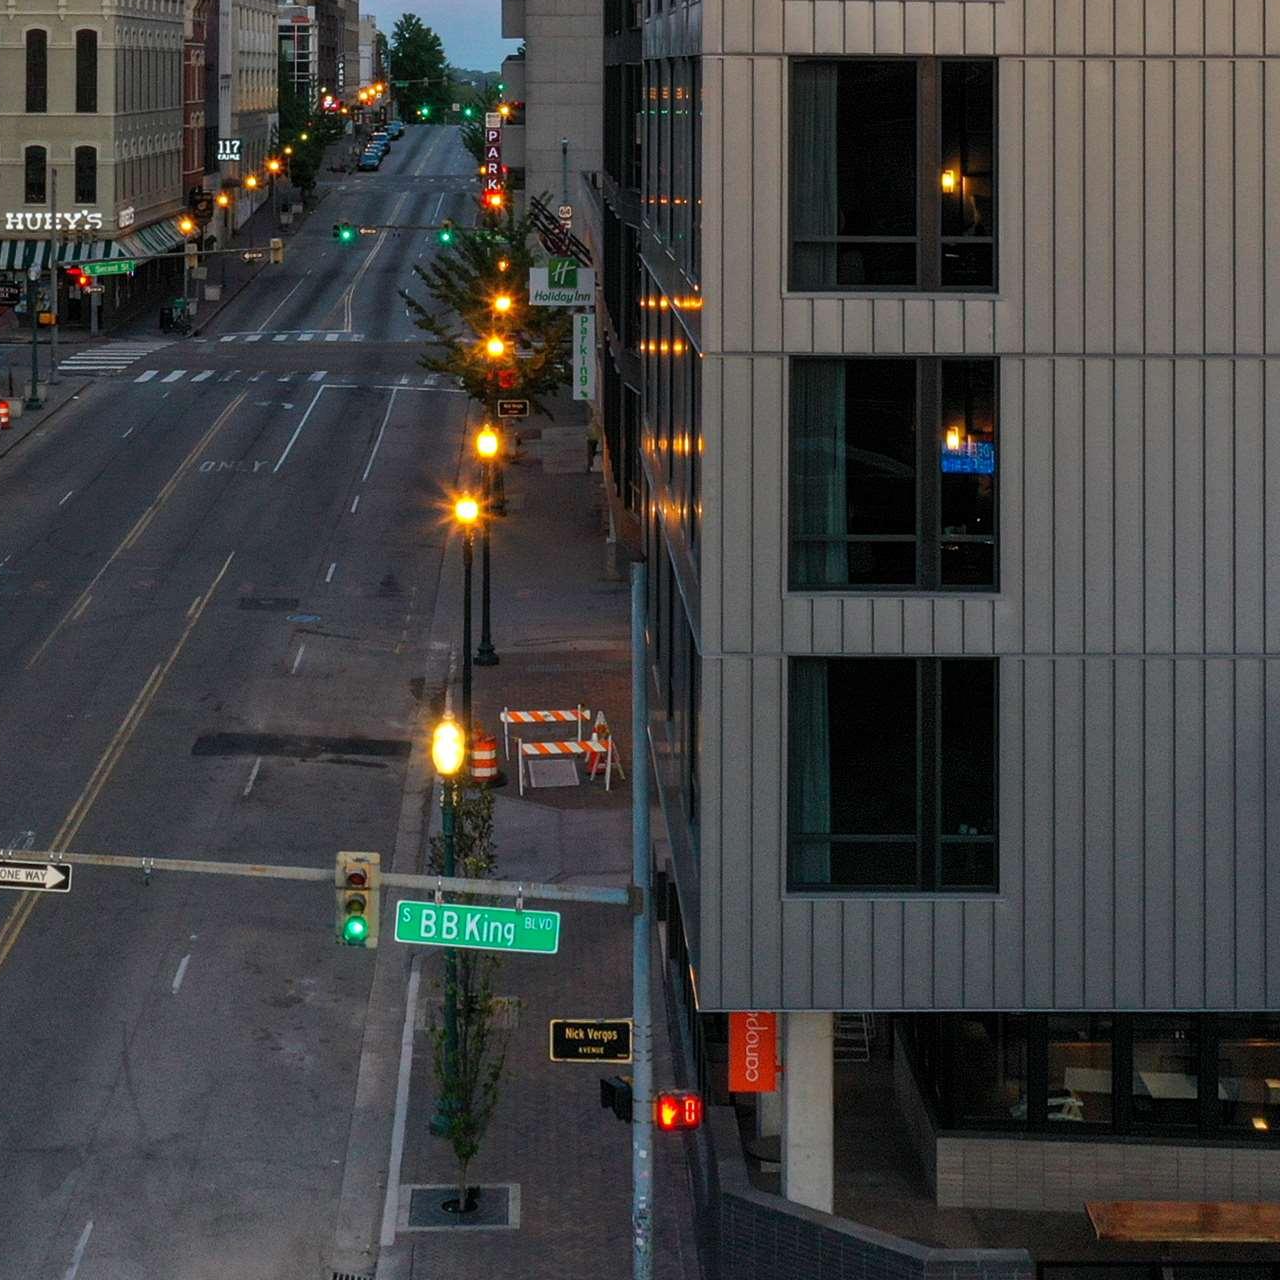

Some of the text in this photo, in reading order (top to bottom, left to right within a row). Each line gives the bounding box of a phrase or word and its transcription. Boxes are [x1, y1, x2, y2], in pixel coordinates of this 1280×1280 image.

[218, 140, 240, 153] 117
[488, 131, 499, 190] PARK
[5, 209, 103, 230] HUEY'S
[535, 290, 591, 303] Holiday Inn
[579, 316, 588, 386] Parking
[0, 868, 47, 881] ONE WAY
[402, 907, 412, 923] S
[464, 912, 516, 946] King
[524, 916, 554, 931] BLVD
[565, 1027, 618, 1043] Nick Vergos
[578, 1046, 605, 1055] AVENUE
[745, 1012, 769, 1082] canop
[685, 1100, 696, 1122] 0
